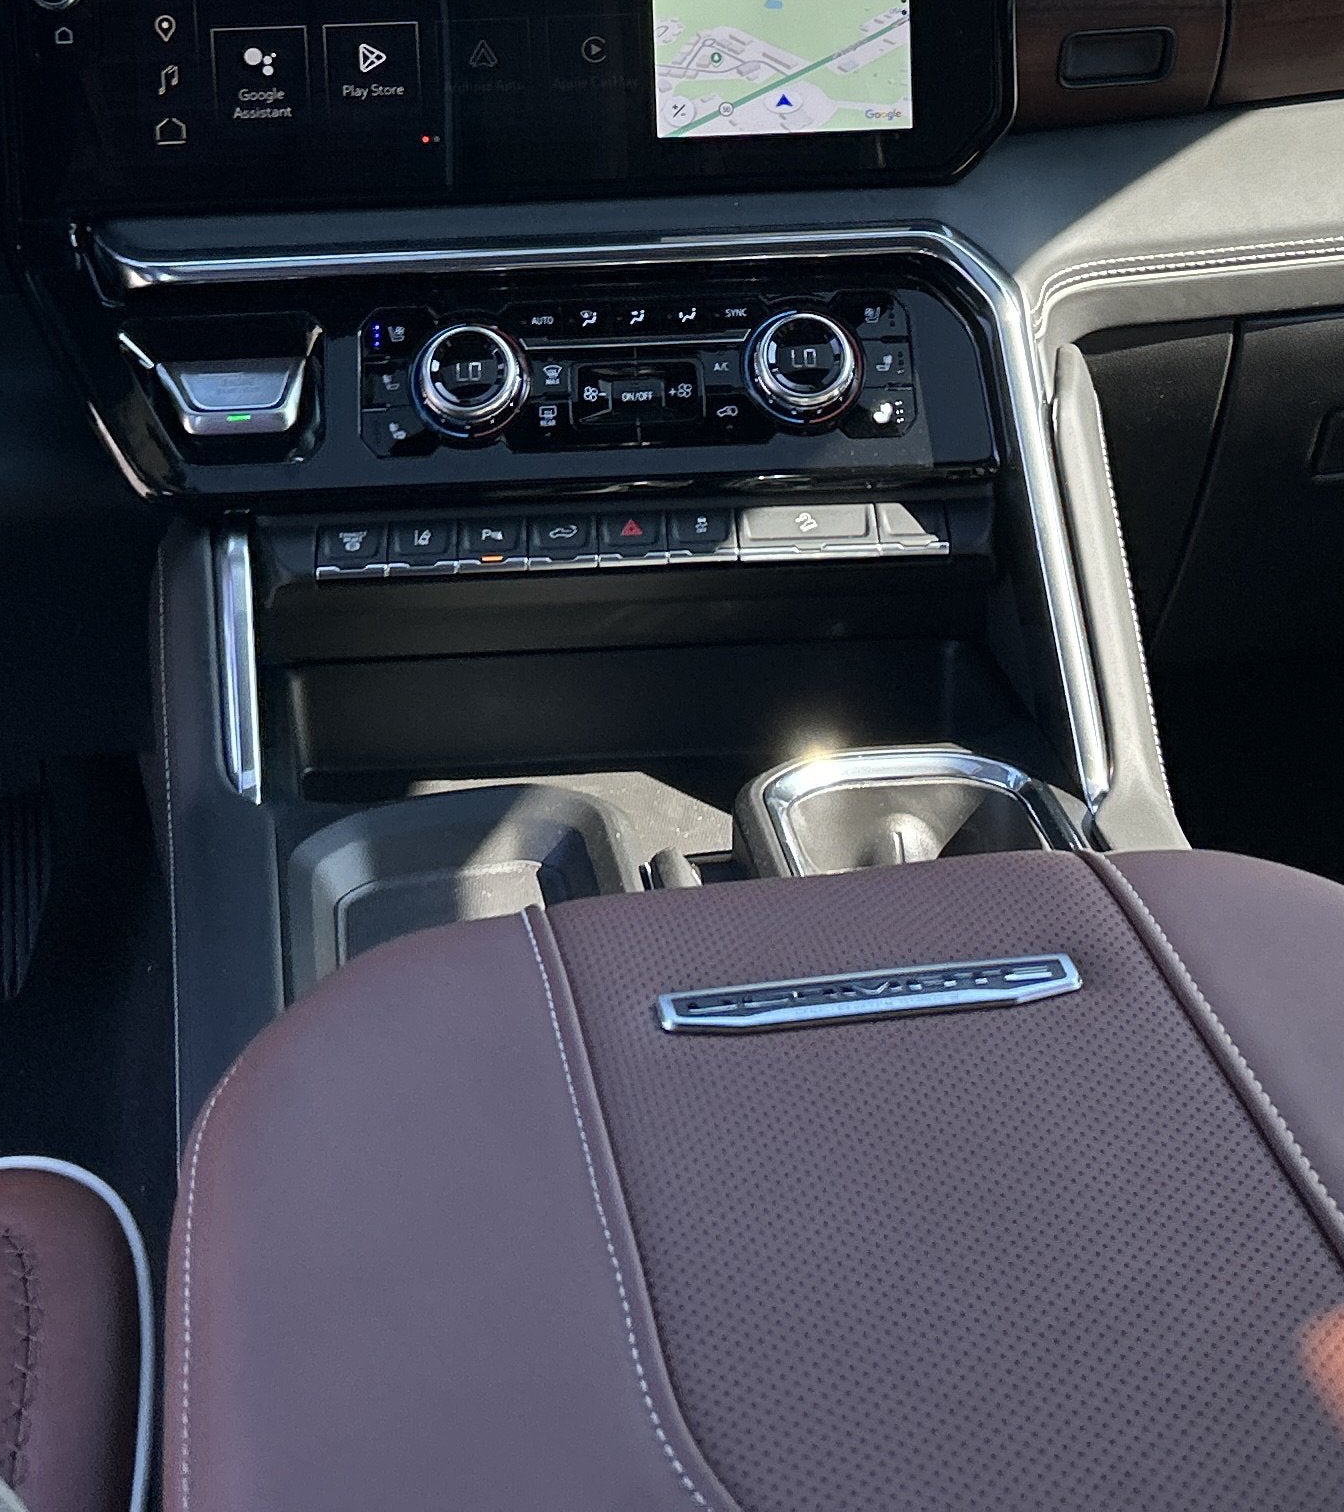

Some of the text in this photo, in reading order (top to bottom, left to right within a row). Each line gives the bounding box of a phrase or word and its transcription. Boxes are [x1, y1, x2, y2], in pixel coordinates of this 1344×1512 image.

[238, 87, 286, 104] Google
[342, 83, 405, 100] Play Store
[232, 107, 293, 120] Assistant
[864, 108, 902, 121] Google
[724, 307, 748, 318] SYNC
[531, 315, 554, 326] AUTO
[713, 361, 730, 372] A/C
[621, 390, 654, 403] ON/OFF
